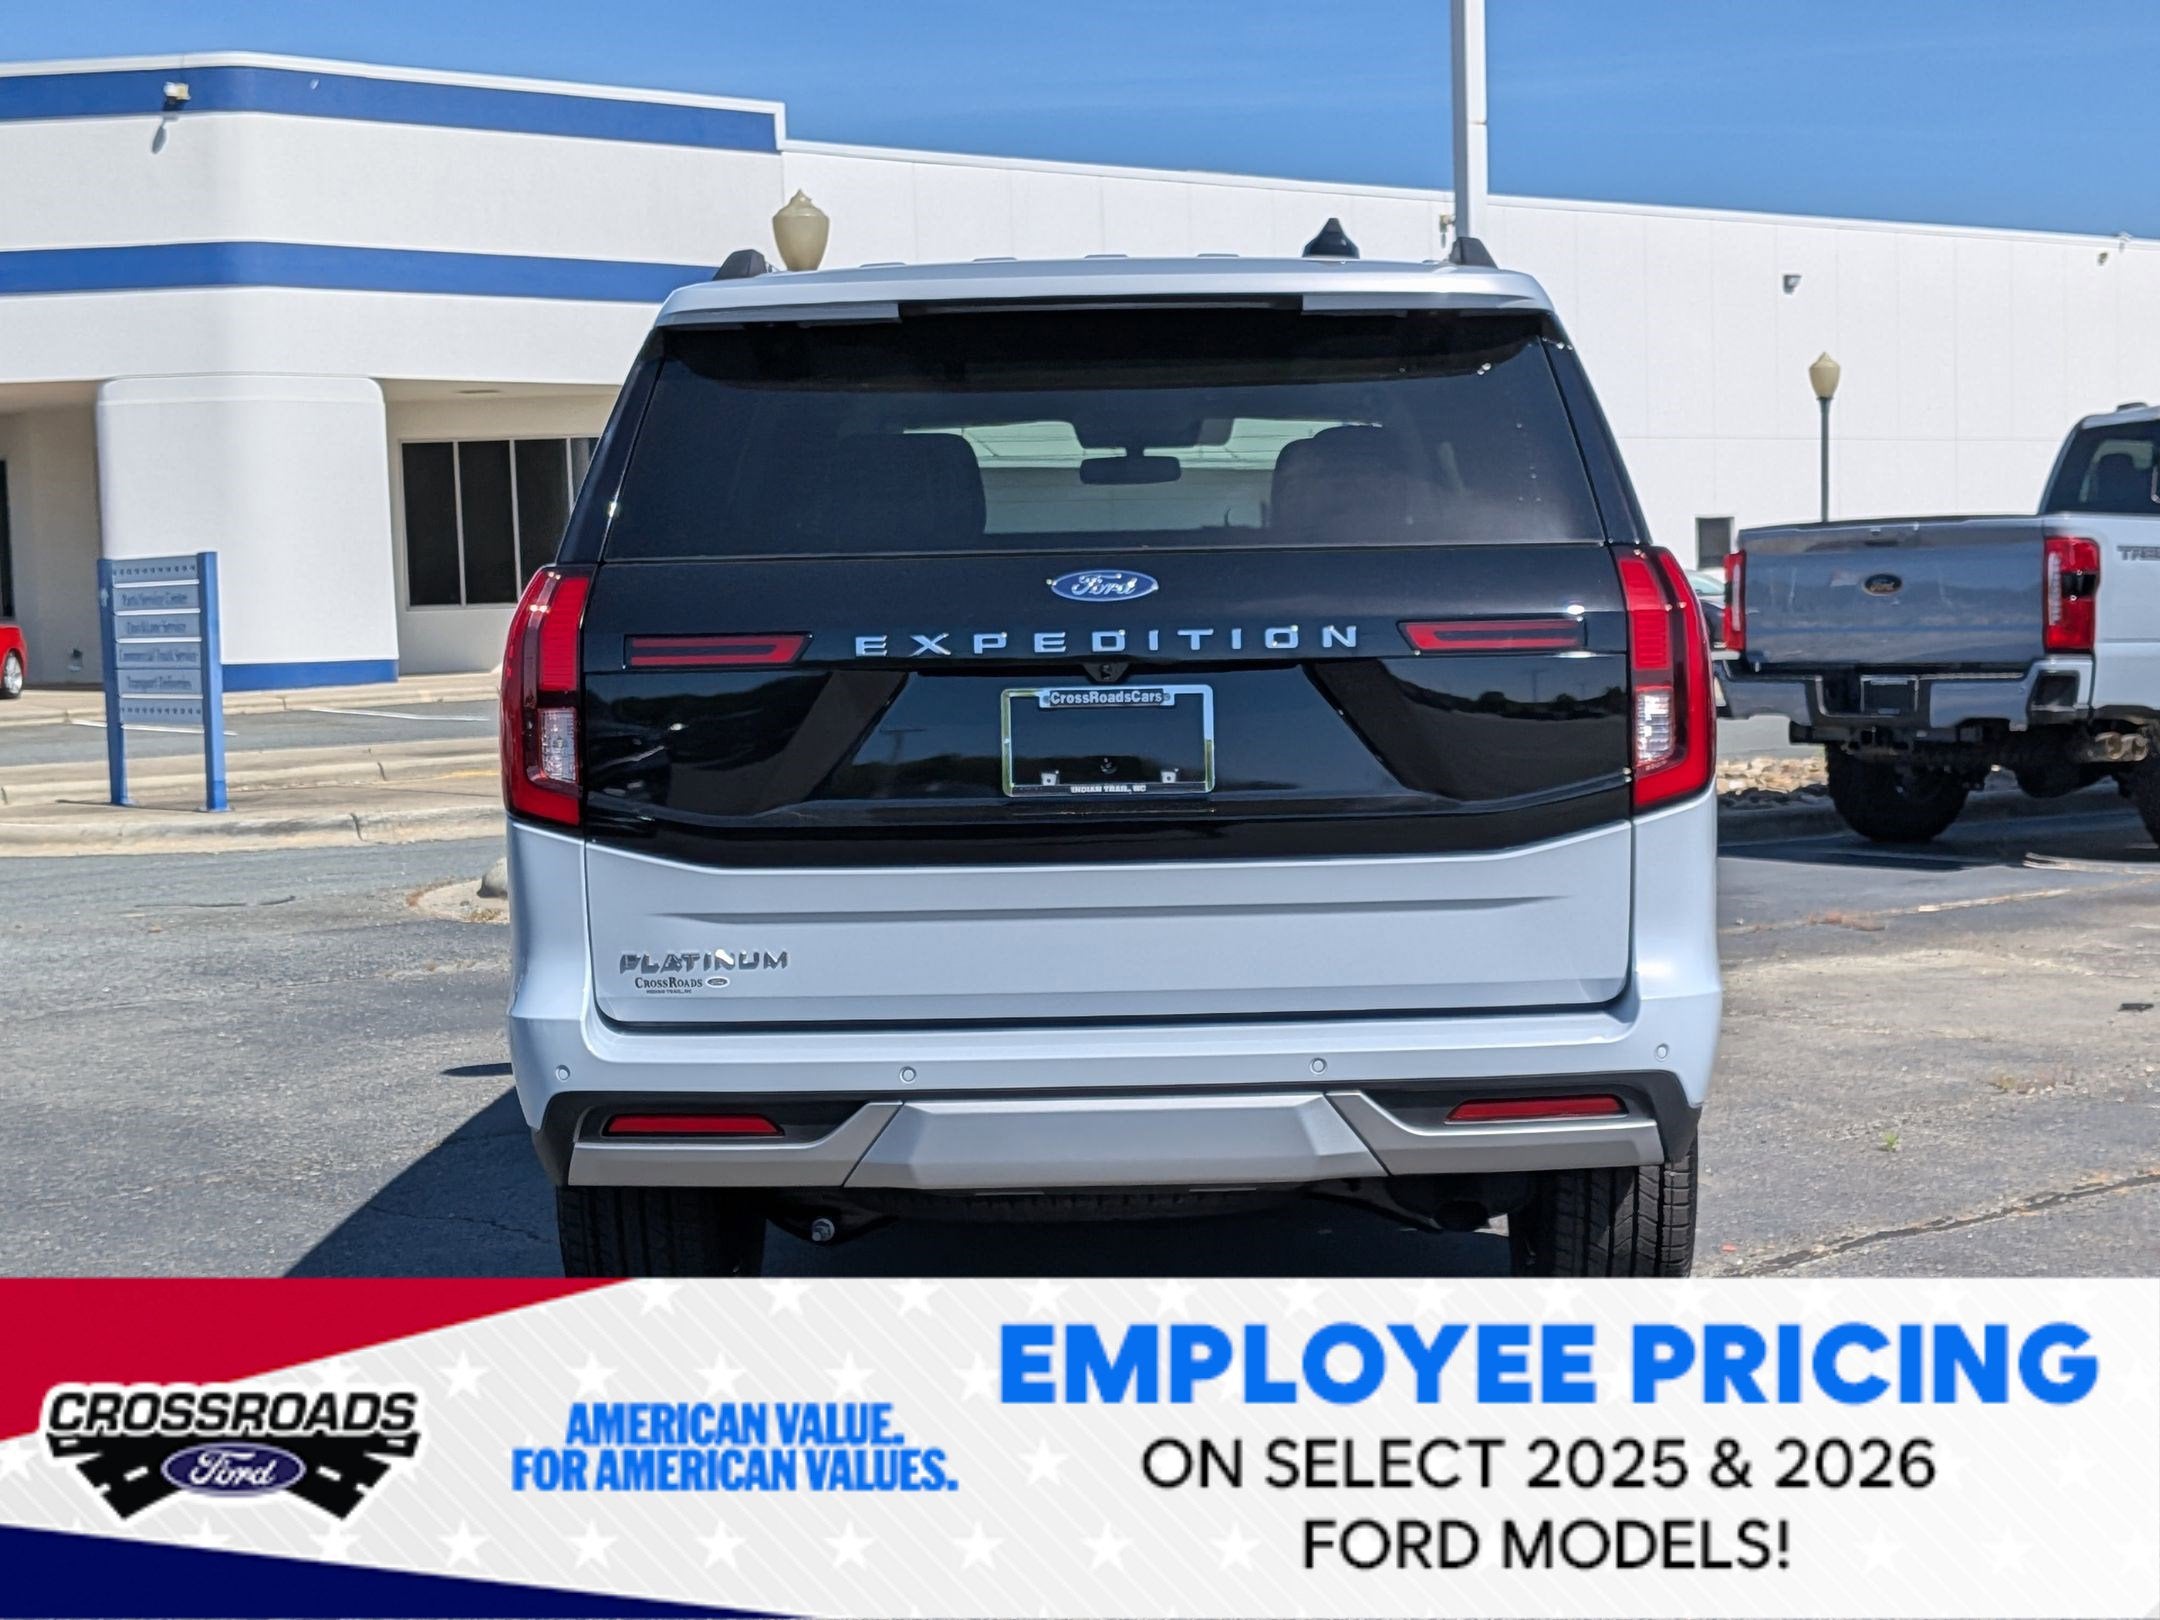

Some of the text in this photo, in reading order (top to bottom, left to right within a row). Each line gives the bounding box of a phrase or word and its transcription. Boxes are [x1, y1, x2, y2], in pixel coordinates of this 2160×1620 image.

[1071, 573, 1138, 596] Ford
[854, 625, 1358, 657] EXPEDITION
[1050, 689, 1162, 704] CrossRoadsCars
[619, 949, 789, 974] PLATINUM
